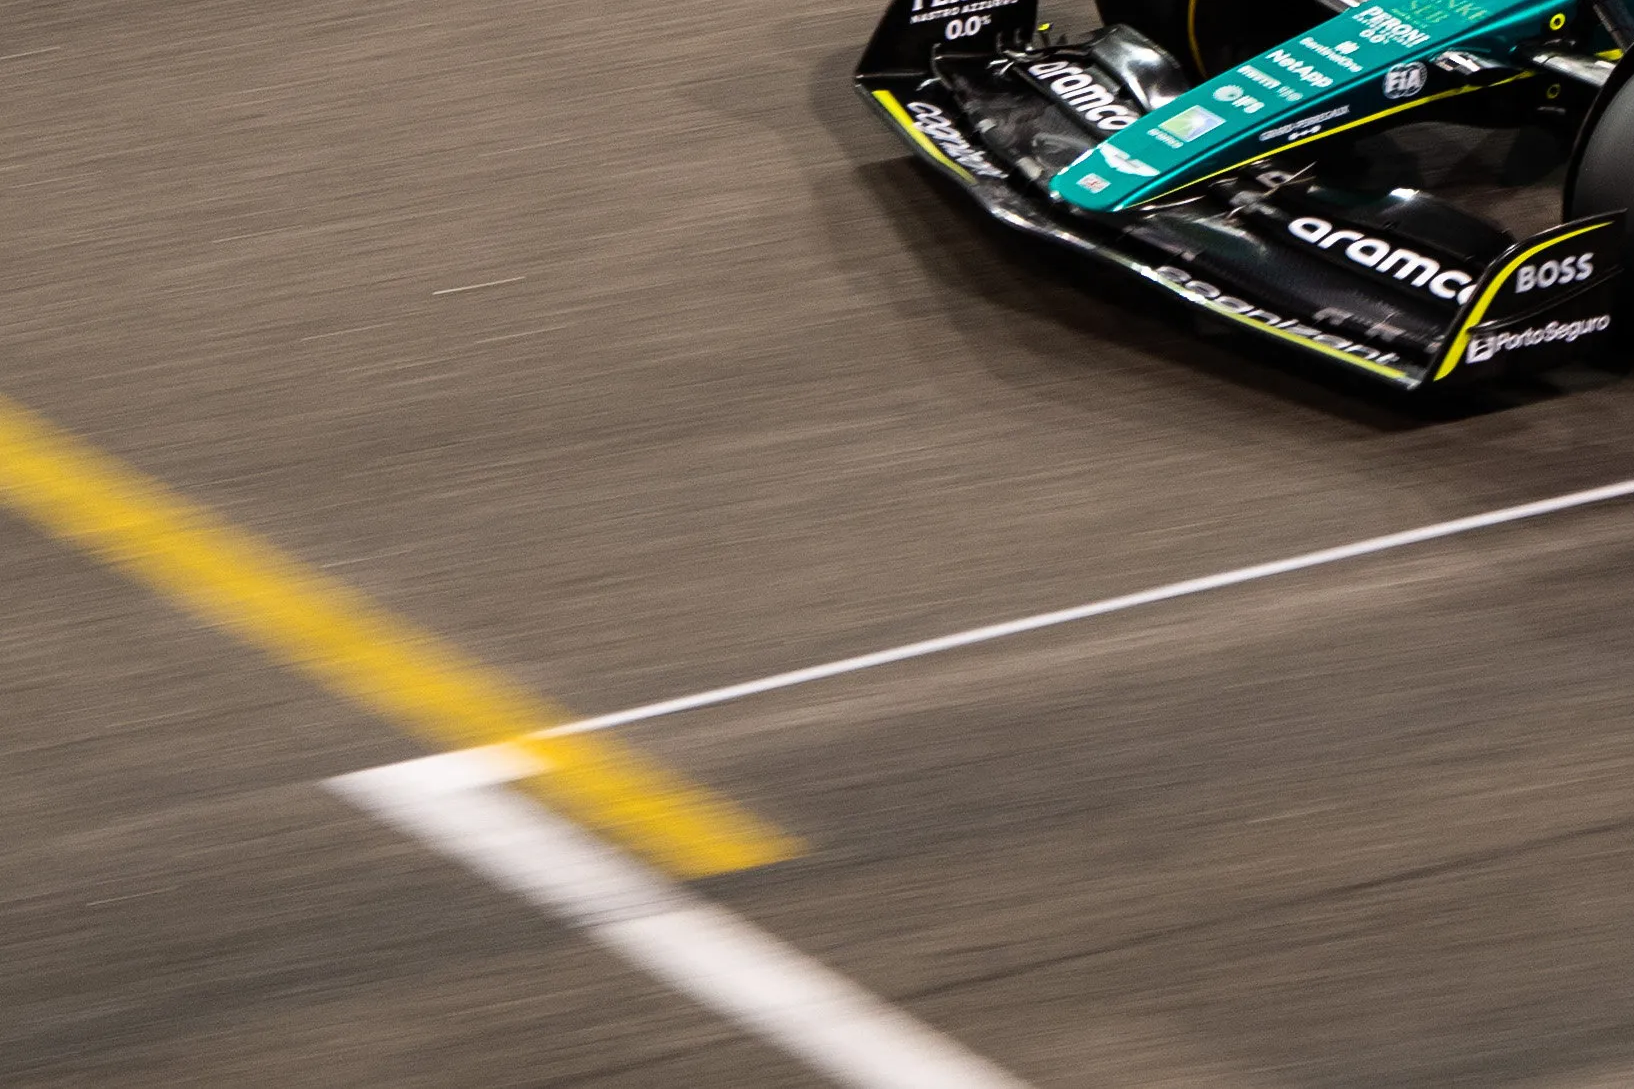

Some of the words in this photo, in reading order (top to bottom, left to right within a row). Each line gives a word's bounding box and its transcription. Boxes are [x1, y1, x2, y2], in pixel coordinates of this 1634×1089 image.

[1265, 49, 1334, 88] NetApp
[1029, 60, 1138, 131] aramco
[1515, 252, 1595, 294] BOSS
